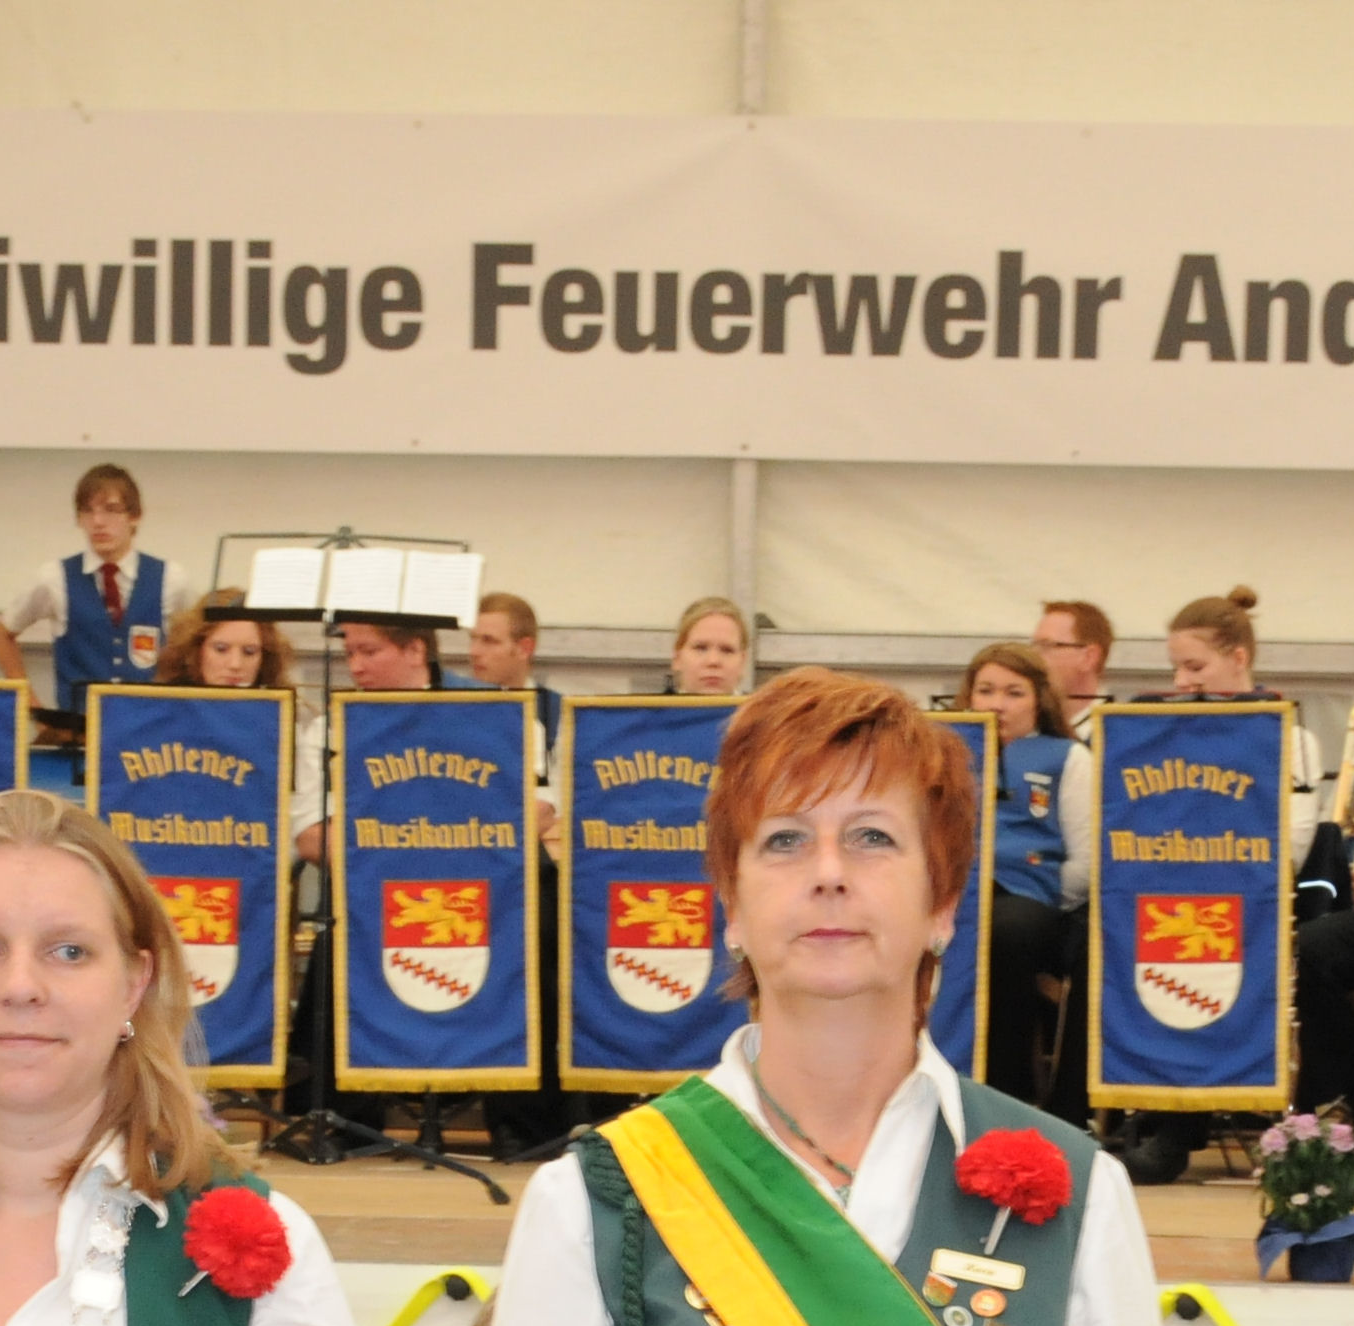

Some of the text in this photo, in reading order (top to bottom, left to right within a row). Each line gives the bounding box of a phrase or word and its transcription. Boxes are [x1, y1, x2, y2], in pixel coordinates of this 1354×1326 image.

[471, 242, 1122, 360] Feuerwehr
[121, 741, 256, 787] Ahltener
[365, 747, 498, 789] Ahltener
[1121, 757, 1253, 800] Ahltener
[109, 811, 271, 848] Musikanten
[355, 817, 517, 849] Musikanten
[1109, 828, 1271, 864] Musikanten
